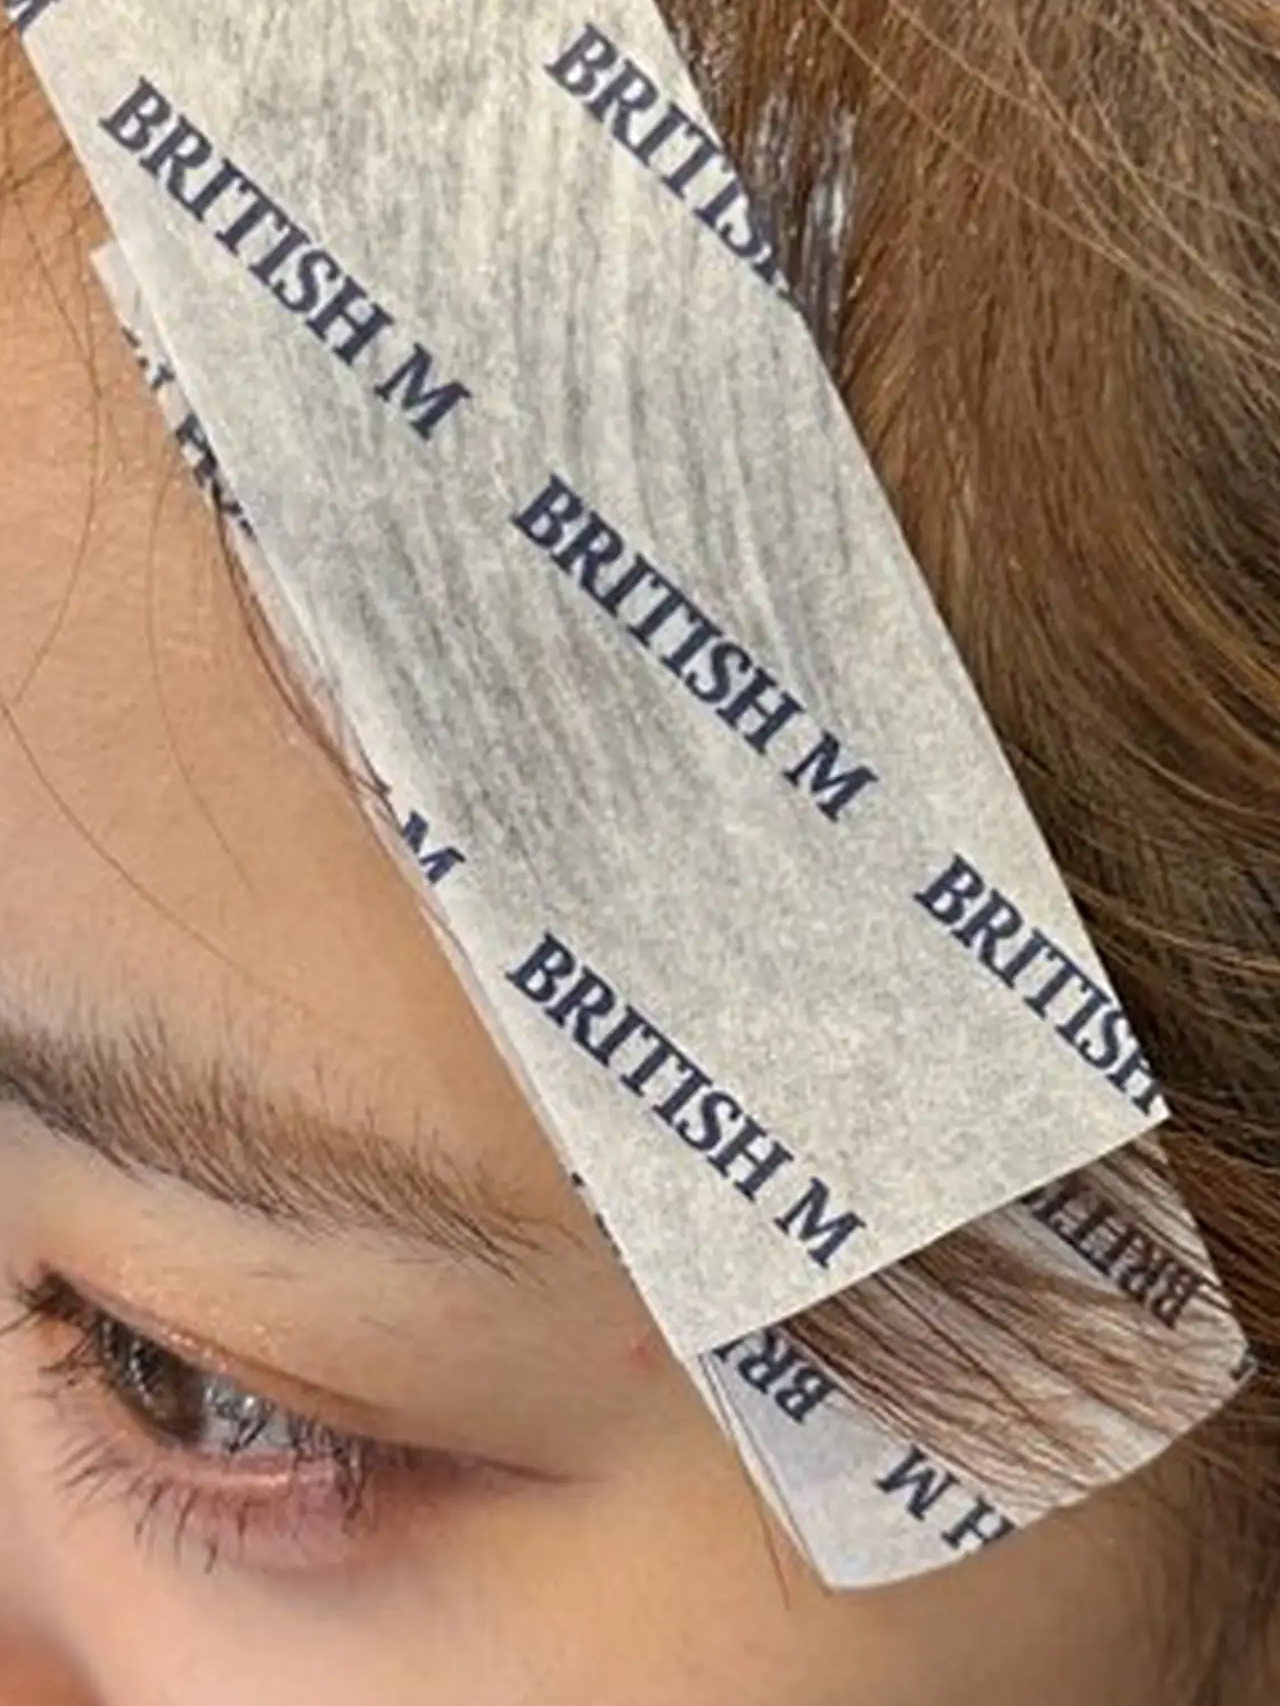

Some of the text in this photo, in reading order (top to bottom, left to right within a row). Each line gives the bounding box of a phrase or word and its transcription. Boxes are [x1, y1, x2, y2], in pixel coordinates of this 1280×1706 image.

[98, 76, 475, 443] BRITISH M
[543, 22, 788, 292] BRITIS
[508, 473, 880, 824] BRITISH M
[504, 931, 868, 1270] BRITISH M
